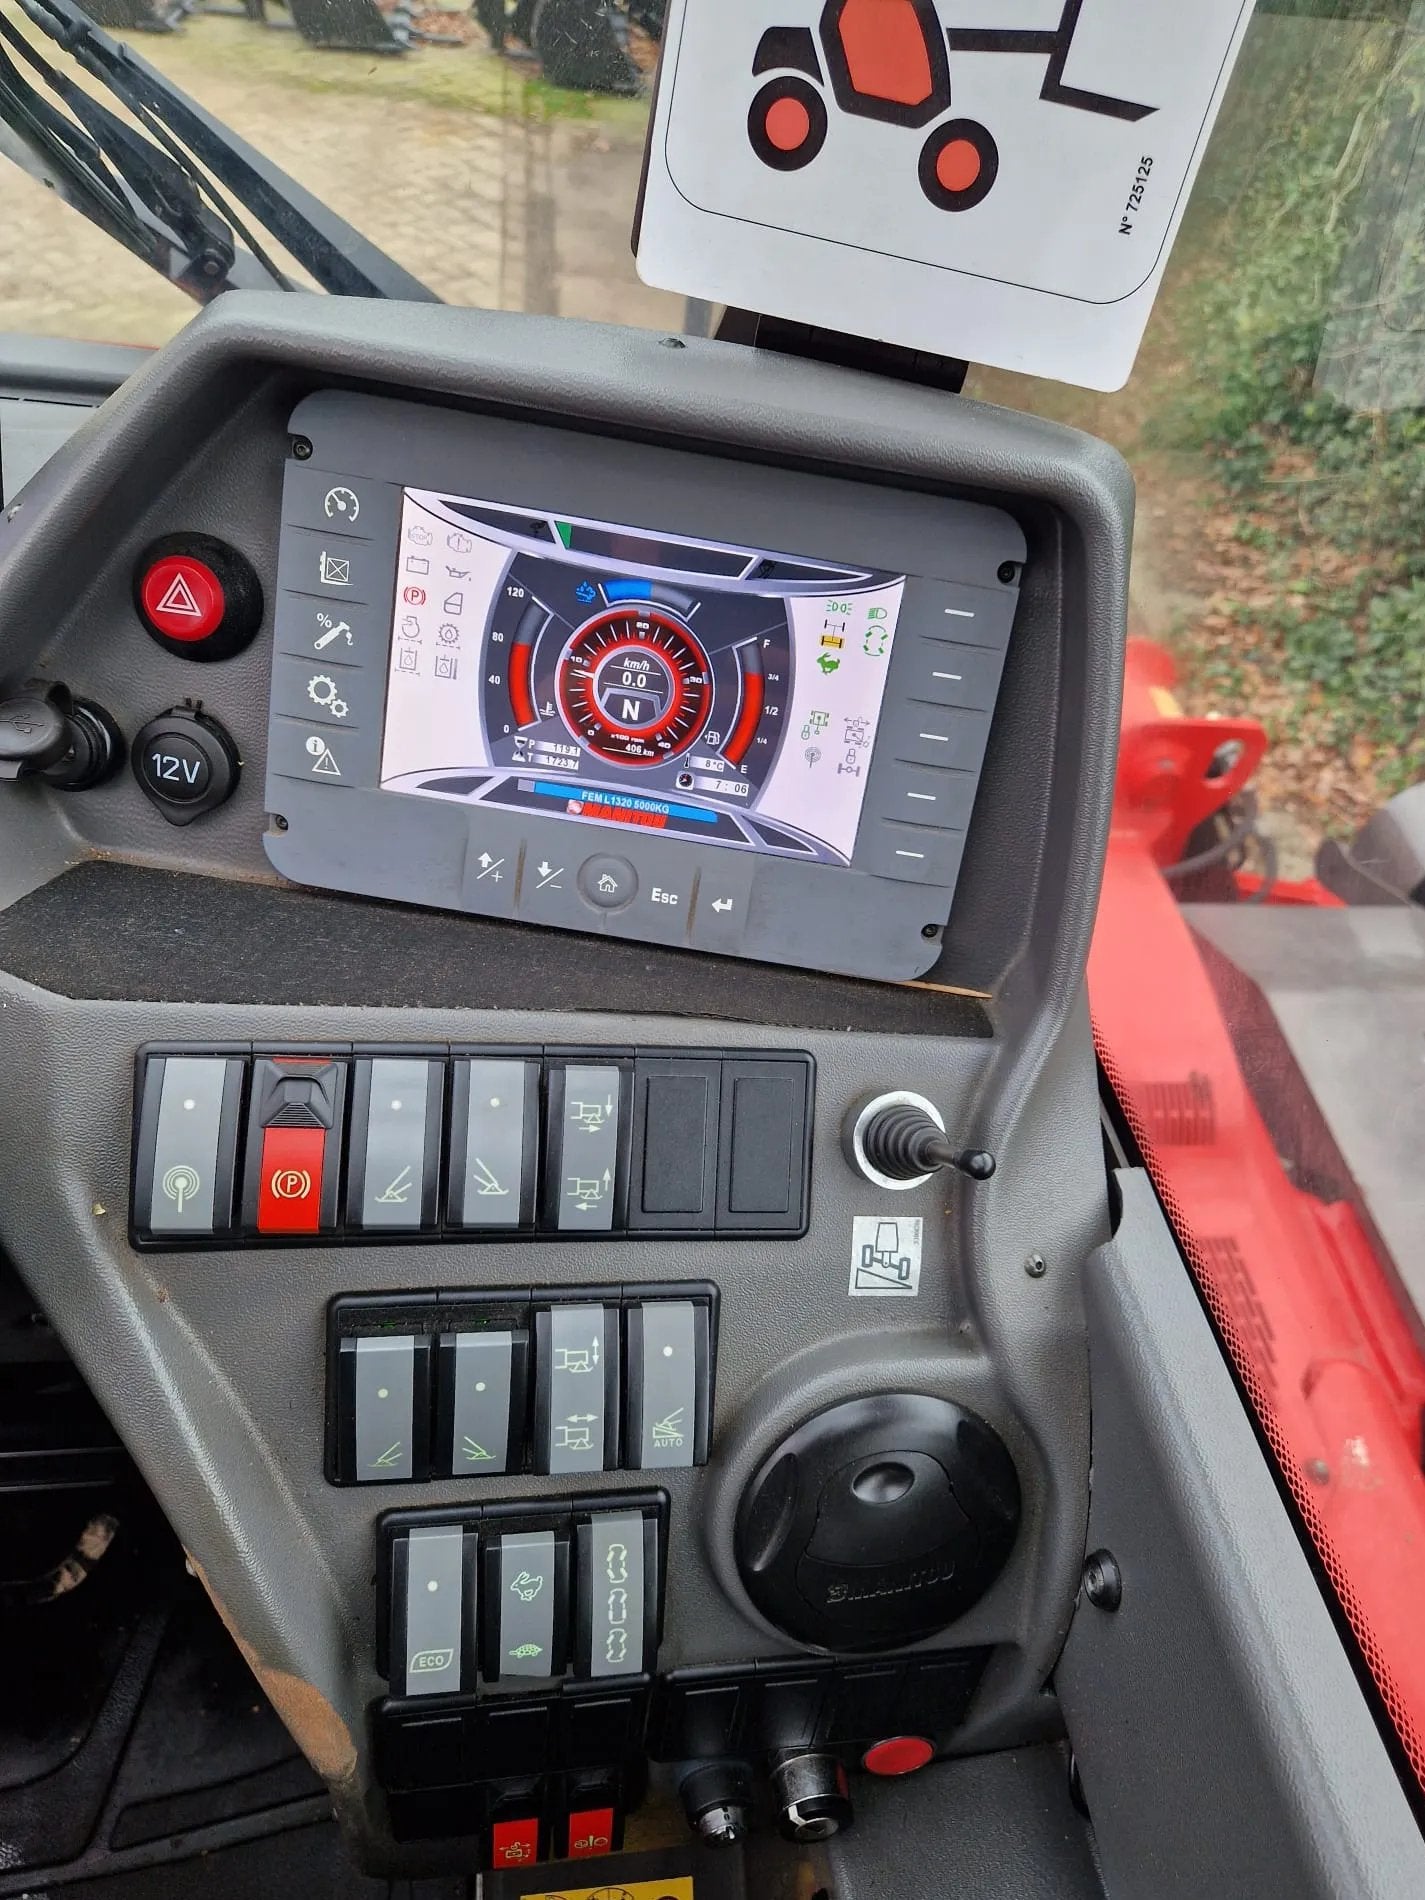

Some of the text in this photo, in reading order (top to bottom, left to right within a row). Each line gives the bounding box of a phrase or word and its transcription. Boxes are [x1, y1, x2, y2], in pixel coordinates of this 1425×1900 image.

[1125, 156, 1153, 212] 725125
[411, 589, 420, 601] P
[506, 586, 524, 598] 120
[492, 631, 504, 642] 80
[763, 639, 771, 649] F
[623, 658, 650, 671] km/h
[488, 675, 501, 685] 40
[622, 671, 647, 688] 0.0
[689, 676, 703, 684] 30
[767, 673, 779, 681] 3/4
[621, 699, 640, 721] N
[764, 705, 779, 716] 1/2
[503, 725, 510, 734] 0
[756, 736, 768, 744] 1/4
[642, 748, 655, 757] km
[152, 753, 201, 784] 12V
[740, 764, 749, 774] E
[581, 791, 669, 814] FEM L1320 5000KG
[286, 1175, 298, 1193] P
[653, 1438, 684, 1448] AUTO
[420, 1655, 444, 1667] ECO
